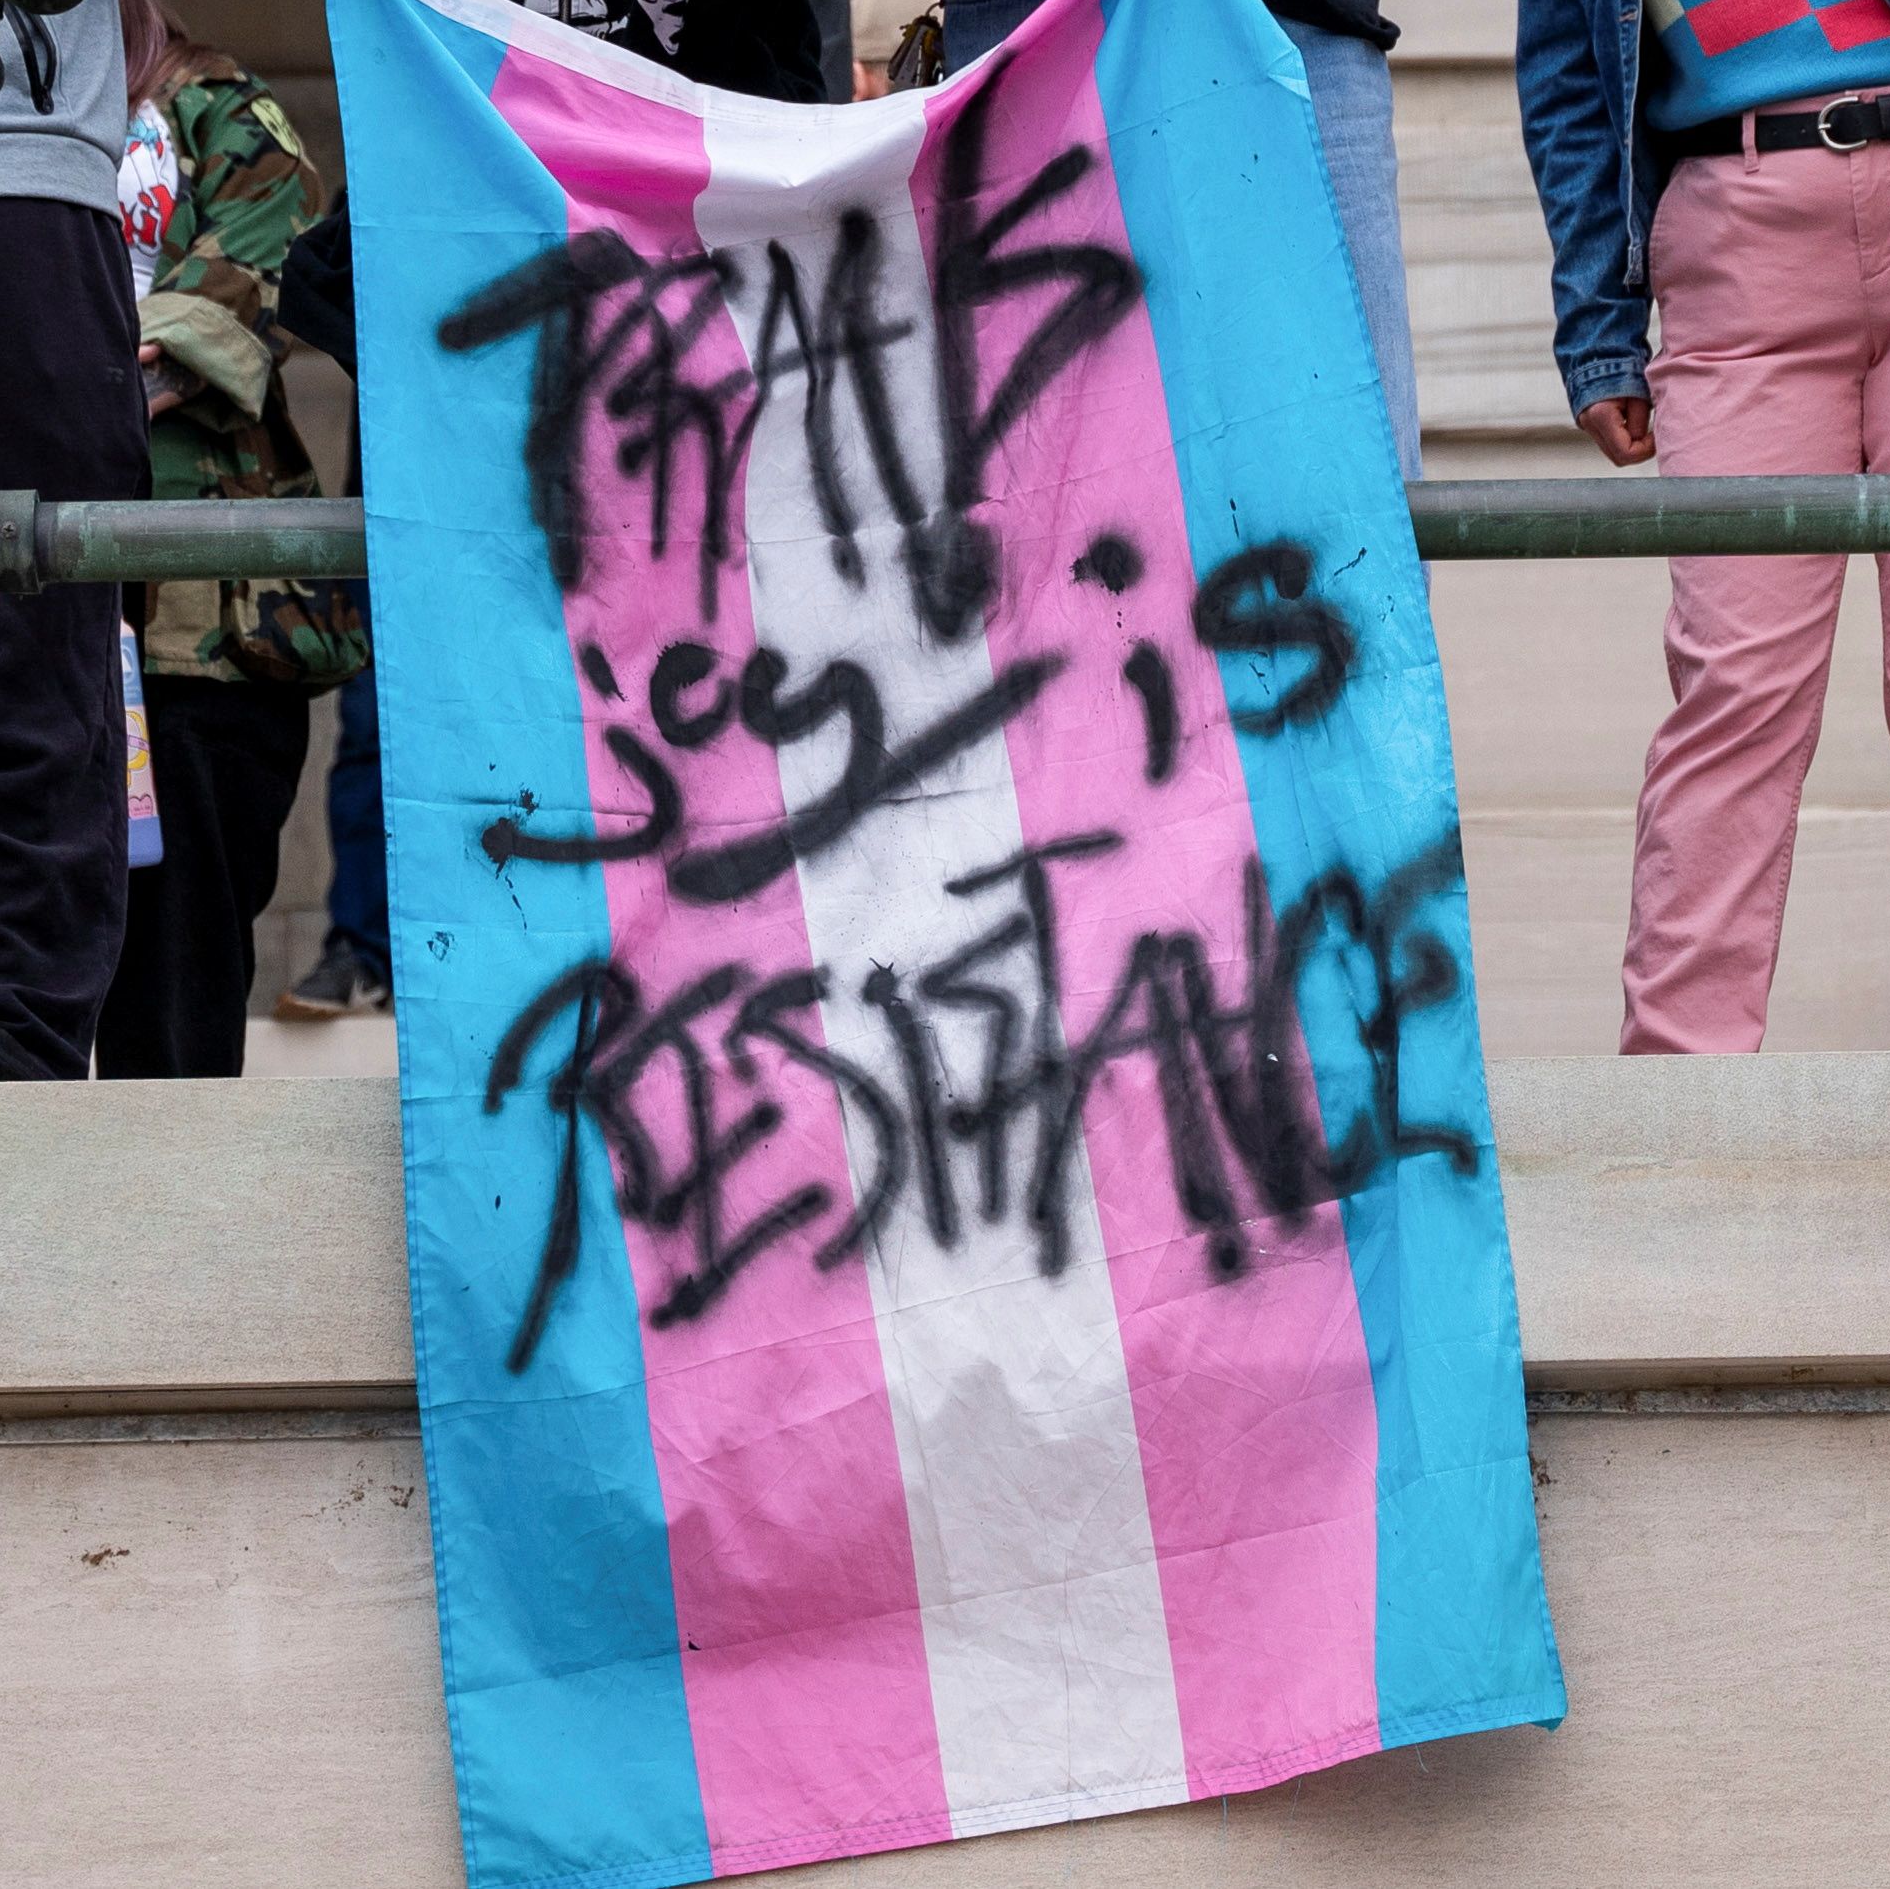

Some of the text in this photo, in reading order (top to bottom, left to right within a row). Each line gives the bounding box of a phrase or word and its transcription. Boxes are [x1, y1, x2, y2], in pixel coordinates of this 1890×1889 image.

[437, 47, 1151, 640] TRANS
[1071, 532, 1356, 784] is
[484, 826, 1481, 1372] RESISTANCE
